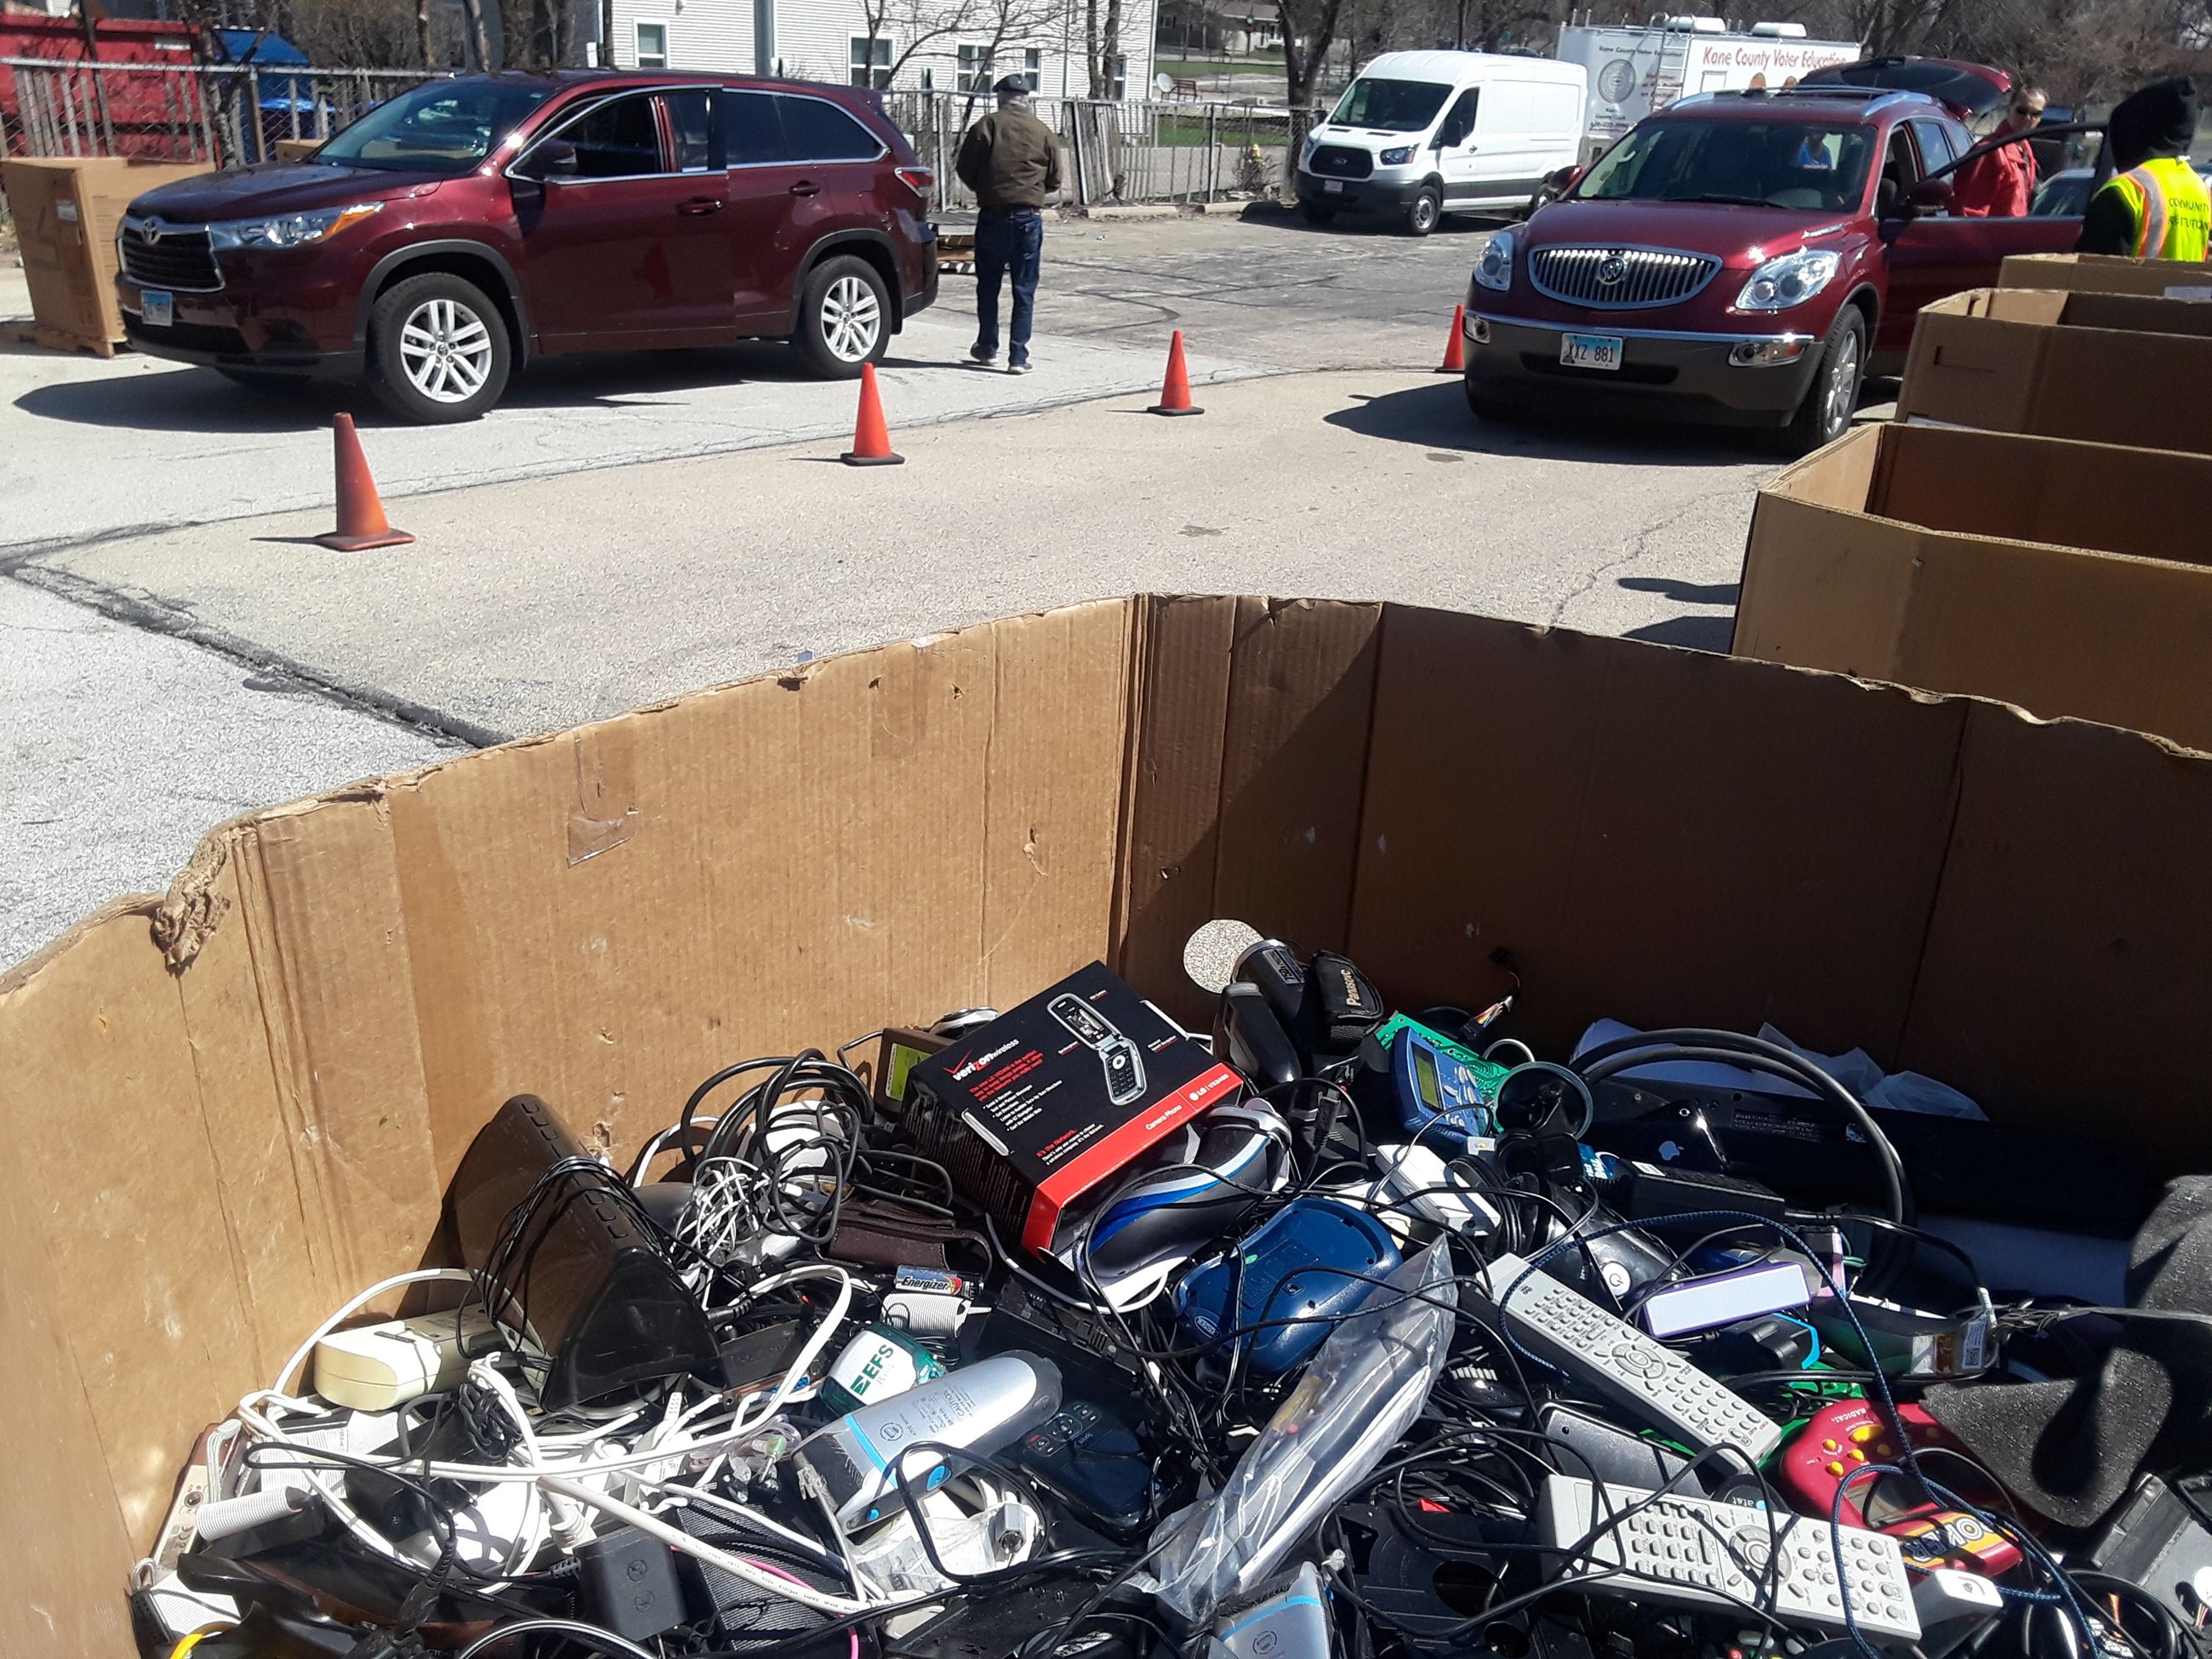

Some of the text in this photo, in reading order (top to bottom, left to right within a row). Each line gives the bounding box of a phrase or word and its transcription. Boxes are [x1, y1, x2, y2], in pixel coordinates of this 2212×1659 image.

[1702, 46, 1732, 66] Kane
[1735, 48, 1770, 71] County
[1773, 49, 1799, 67] Voter
[1594, 346, 1614, 362] 881
[1340, 969, 1361, 1006] Panasonic
[1196, 1087, 1207, 1097] LG
[1145, 1105, 1183, 1131] Camera Phone
[902, 1276, 948, 1291] Energizer
[862, 1344, 894, 1380] EFS
[1732, 1497, 1754, 1507] at&t
